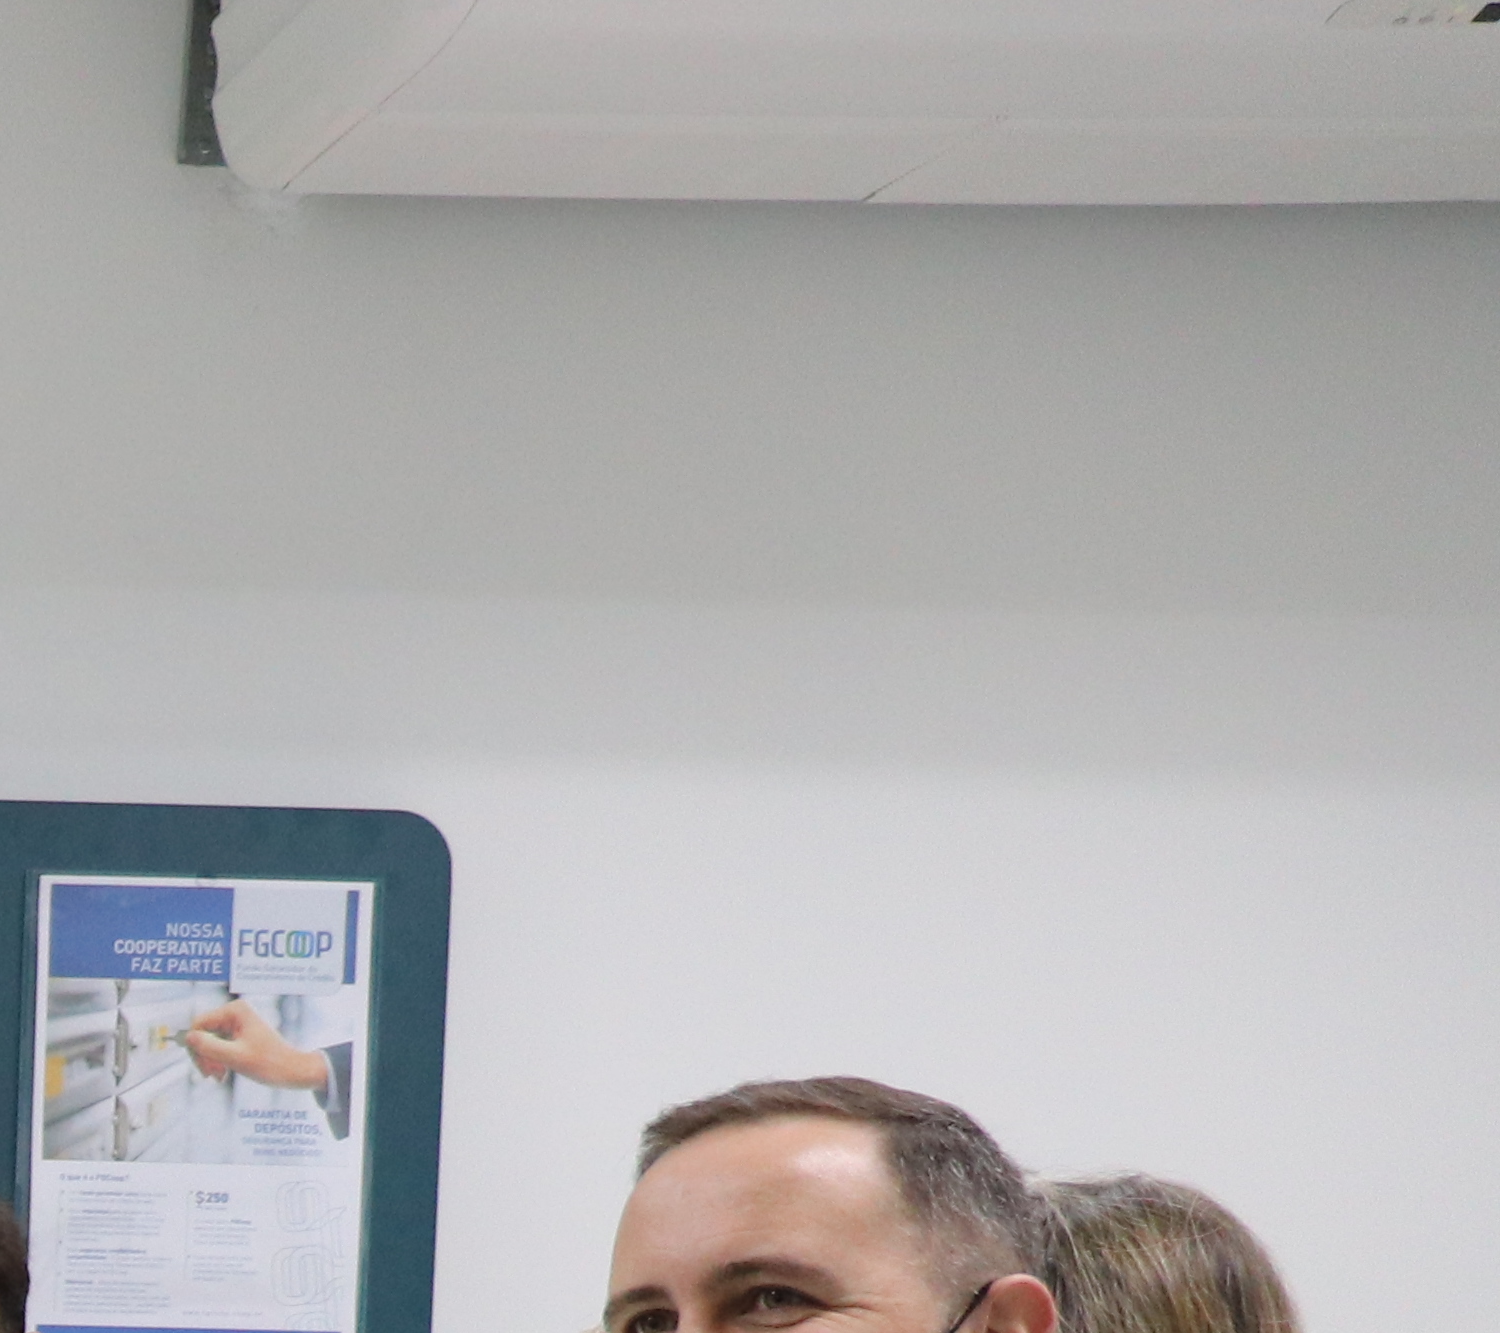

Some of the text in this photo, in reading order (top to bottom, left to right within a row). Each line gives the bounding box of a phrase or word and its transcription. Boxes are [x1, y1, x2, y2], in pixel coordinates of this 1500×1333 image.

[166, 922, 225, 938] NOSSA
[114, 938, 225, 957] COOPERATIVA
[237, 929, 333, 959] FGCOOP
[131, 957, 223, 975] FAZ PARTE
